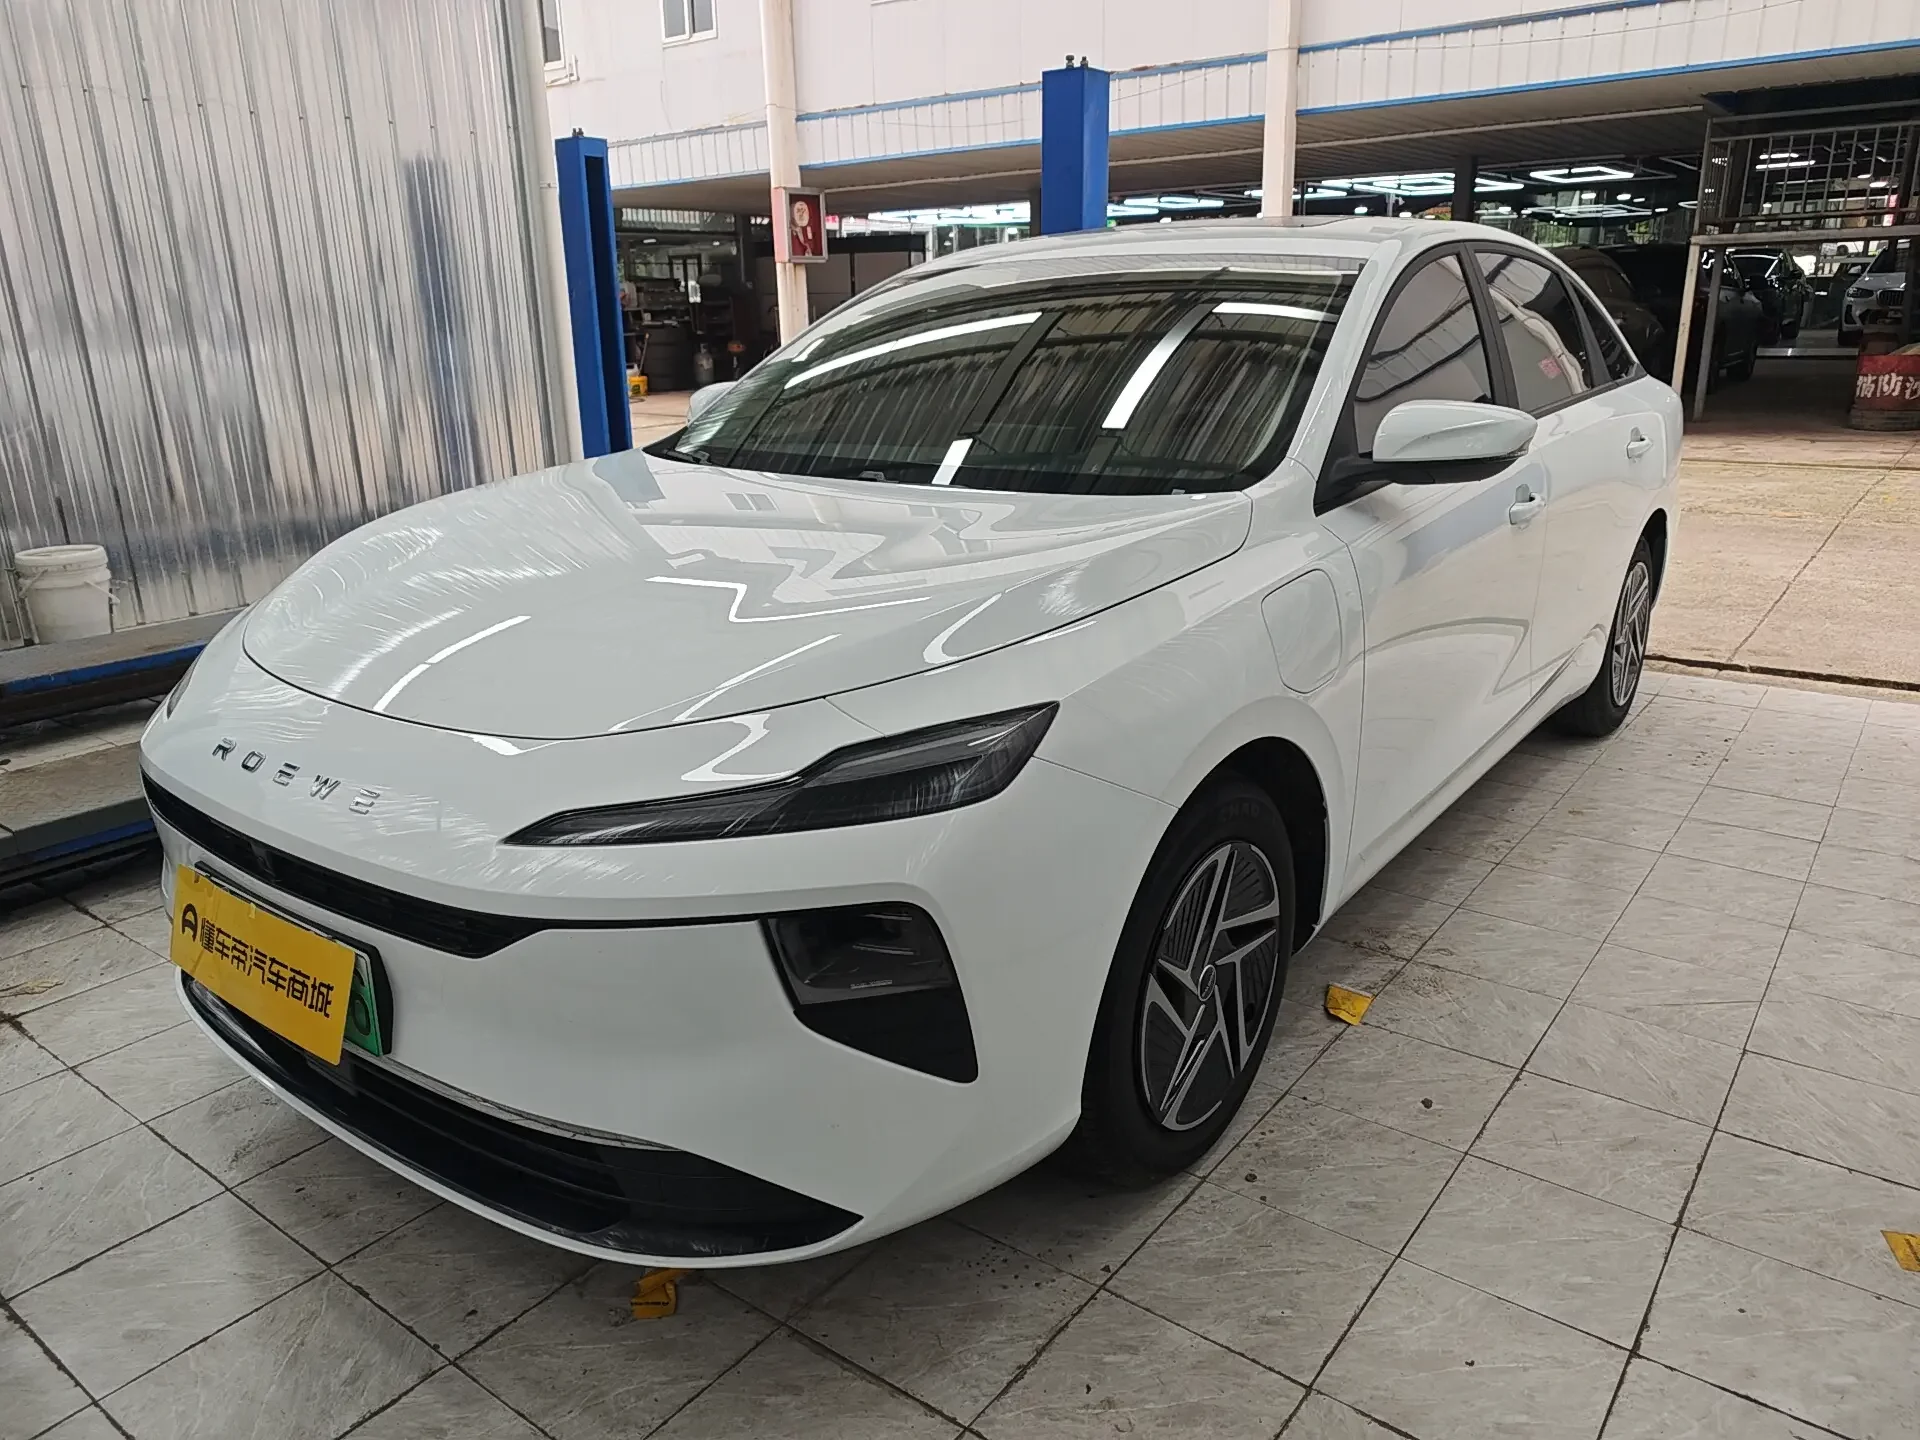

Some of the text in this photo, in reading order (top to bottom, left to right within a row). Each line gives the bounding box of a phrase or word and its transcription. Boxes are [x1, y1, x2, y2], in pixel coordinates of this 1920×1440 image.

[212, 737, 380, 815] ROEWE
[201, 917, 334, 1018] 懂车帝汽车商城
